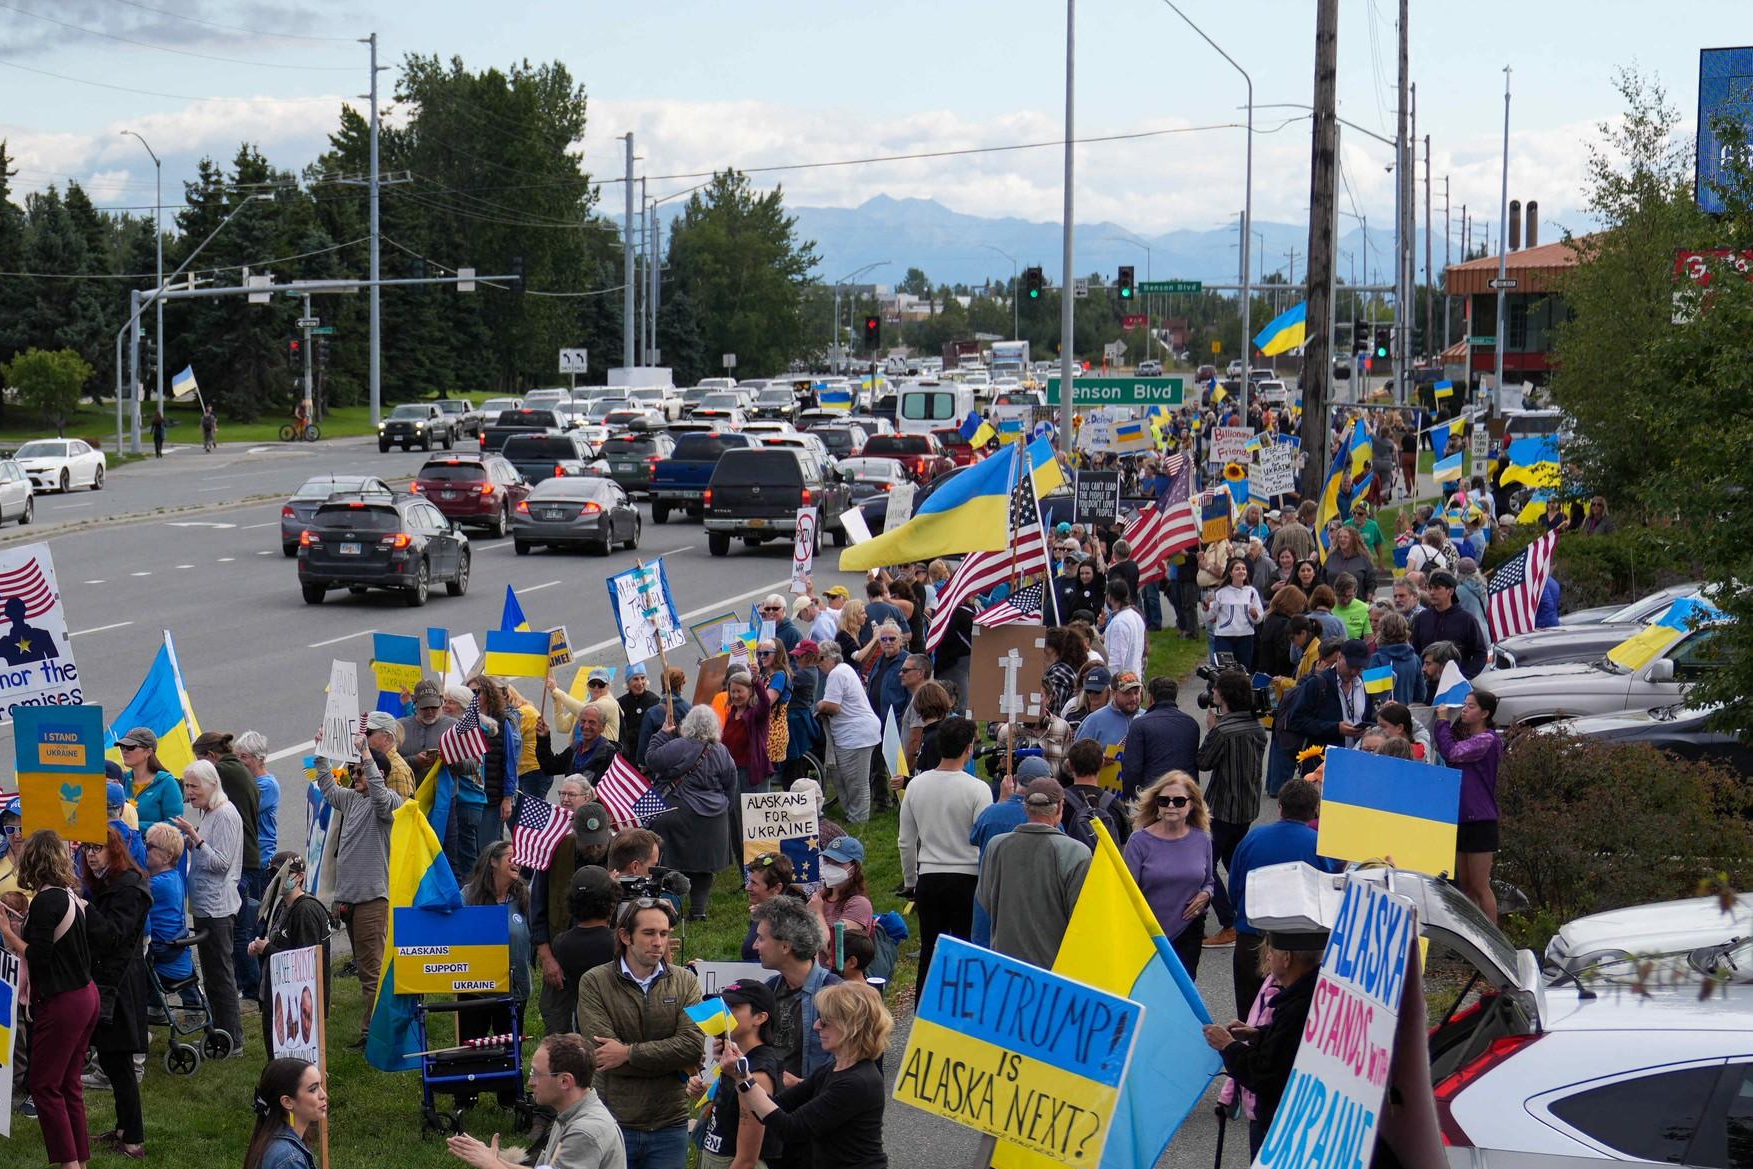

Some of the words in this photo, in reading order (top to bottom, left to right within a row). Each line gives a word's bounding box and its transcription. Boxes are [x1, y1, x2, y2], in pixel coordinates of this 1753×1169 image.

[1144, 284, 1174, 292] Benson
[1059, 384, 1121, 399] enson
[1134, 384, 1172, 399] Blvd
[1080, 482, 1090, 490] YOU
[1091, 481, 1104, 490] CAN'T
[1105, 482, 1116, 491] LEAD
[1079, 491, 1088, 500] THE
[1089, 491, 1104, 500] PEOPLE
[1106, 491, 1110, 500] IF
[1078, 500, 1088, 508] YOU
[1102, 500, 1114, 508] LOVE
[1081, 508, 1089, 516] THE
[41, 659, 78, 684] the
[44, 733, 47, 741] I
[50, 733, 78, 742] STAND
[46, 749, 78, 758] UKRAINE
[746, 793, 807, 810] ALASKANS
[764, 810, 790, 823] FOR
[747, 821, 814, 839] UKRAINE
[1322, 880, 1412, 1010] ALASKA
[400, 946, 449, 956] ALASKANS
[424, 964, 468, 973] SUPPORT
[454, 981, 494, 990] UKRAINE
[938, 956, 1000, 1026] HEY
[996, 969, 1129, 1071] TRUMP!
[1304, 977, 1374, 1078] STANDS
[996, 1051, 1022, 1082] IS
[897, 1047, 995, 1126] ALASKA
[1004, 1084, 1102, 1159] NEXT?
